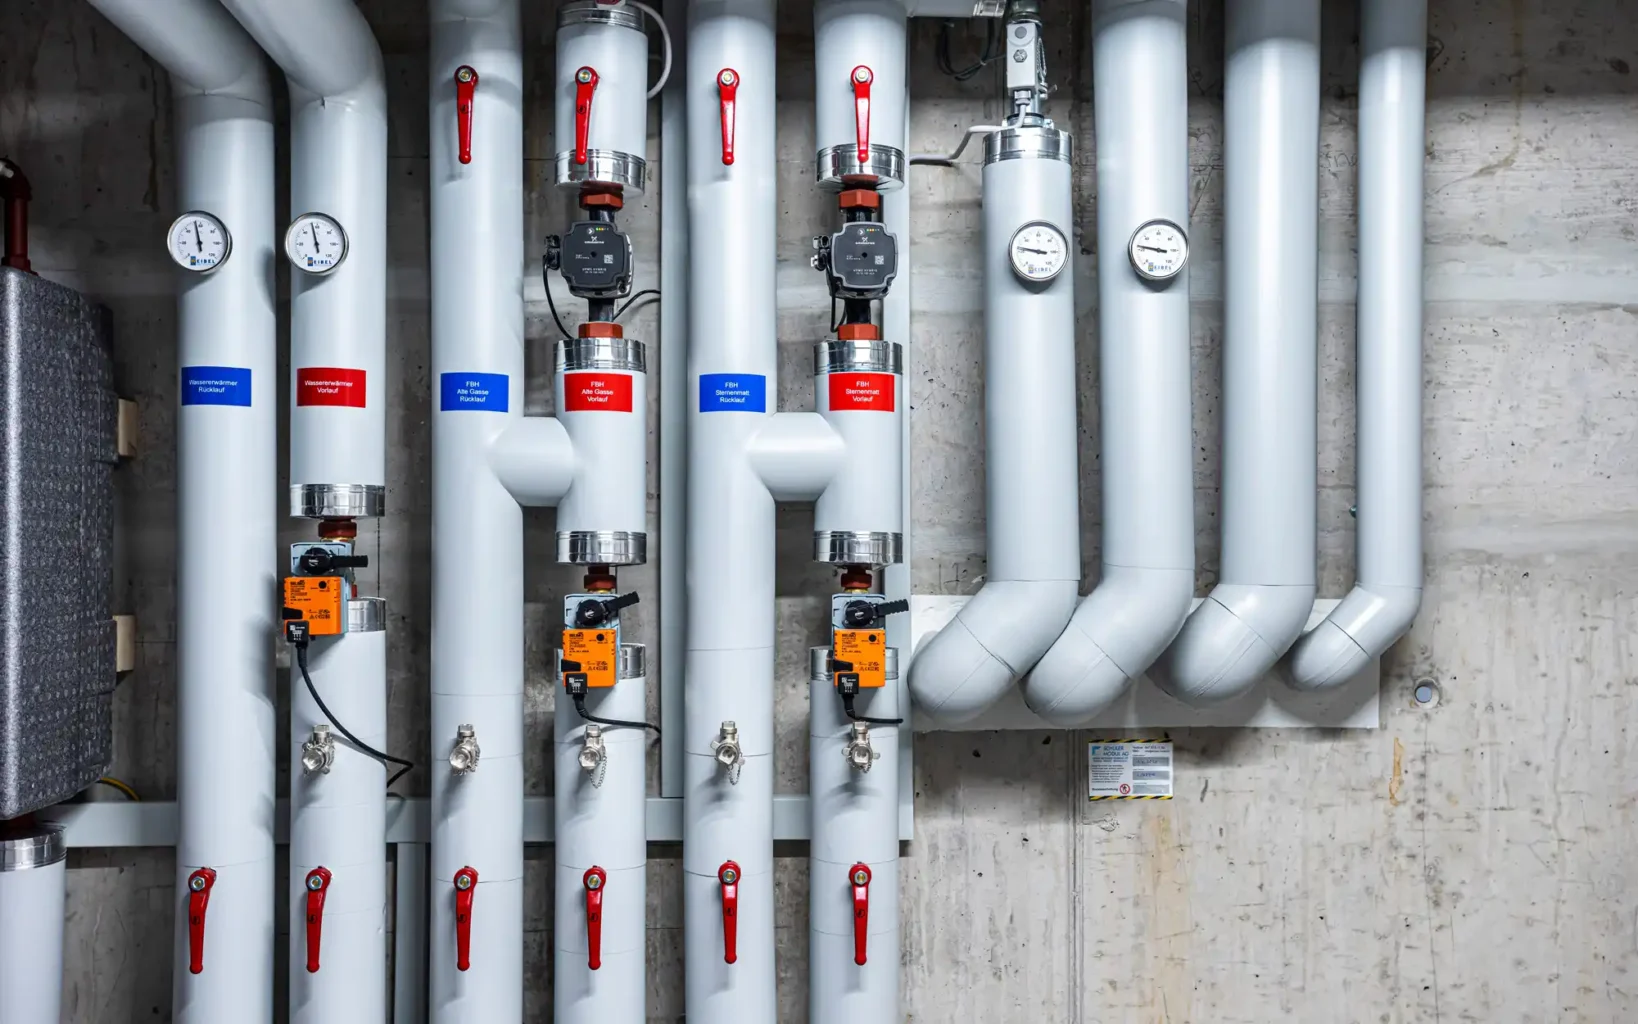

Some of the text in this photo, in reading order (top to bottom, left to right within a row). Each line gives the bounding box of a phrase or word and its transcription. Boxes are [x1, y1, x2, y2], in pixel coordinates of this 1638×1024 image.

[465, 380, 480, 388] FBH
[469, 388, 489, 396] Gasse
[594, 388, 614, 396] Gasse
[459, 395, 486, 403] Rücklauf
[586, 395, 608, 403] Vorlauf
